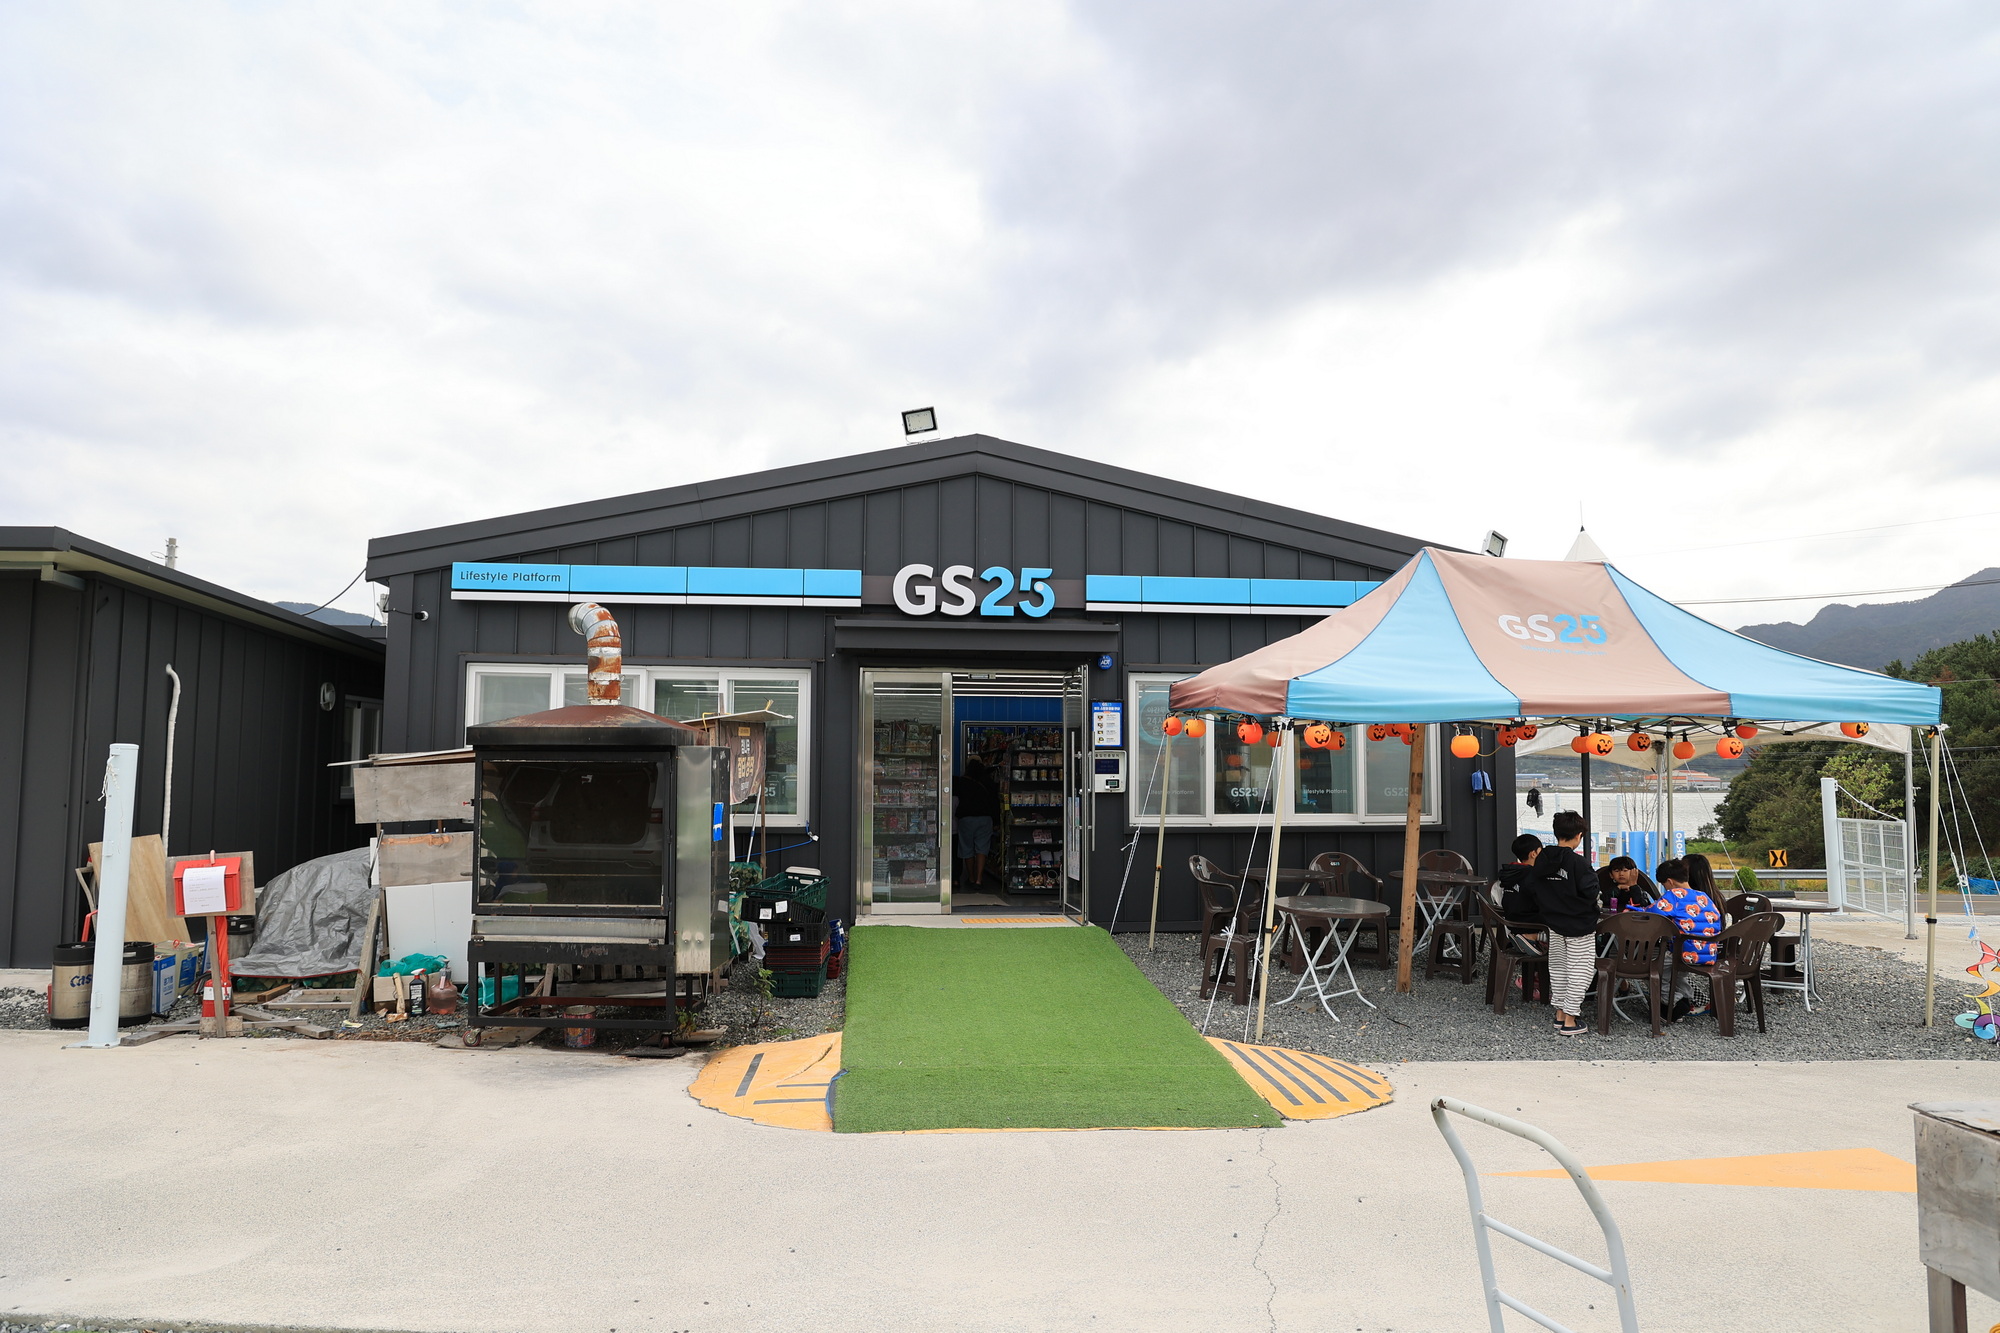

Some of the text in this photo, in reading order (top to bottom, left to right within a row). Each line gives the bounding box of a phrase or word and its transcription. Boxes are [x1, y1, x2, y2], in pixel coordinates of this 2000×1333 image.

[460, 571, 561, 583] Lifestyle Platform
[892, 563, 1056, 618] GS25
[1498, 614, 1608, 645] GS25
[1230, 787, 1259, 797] GS25
